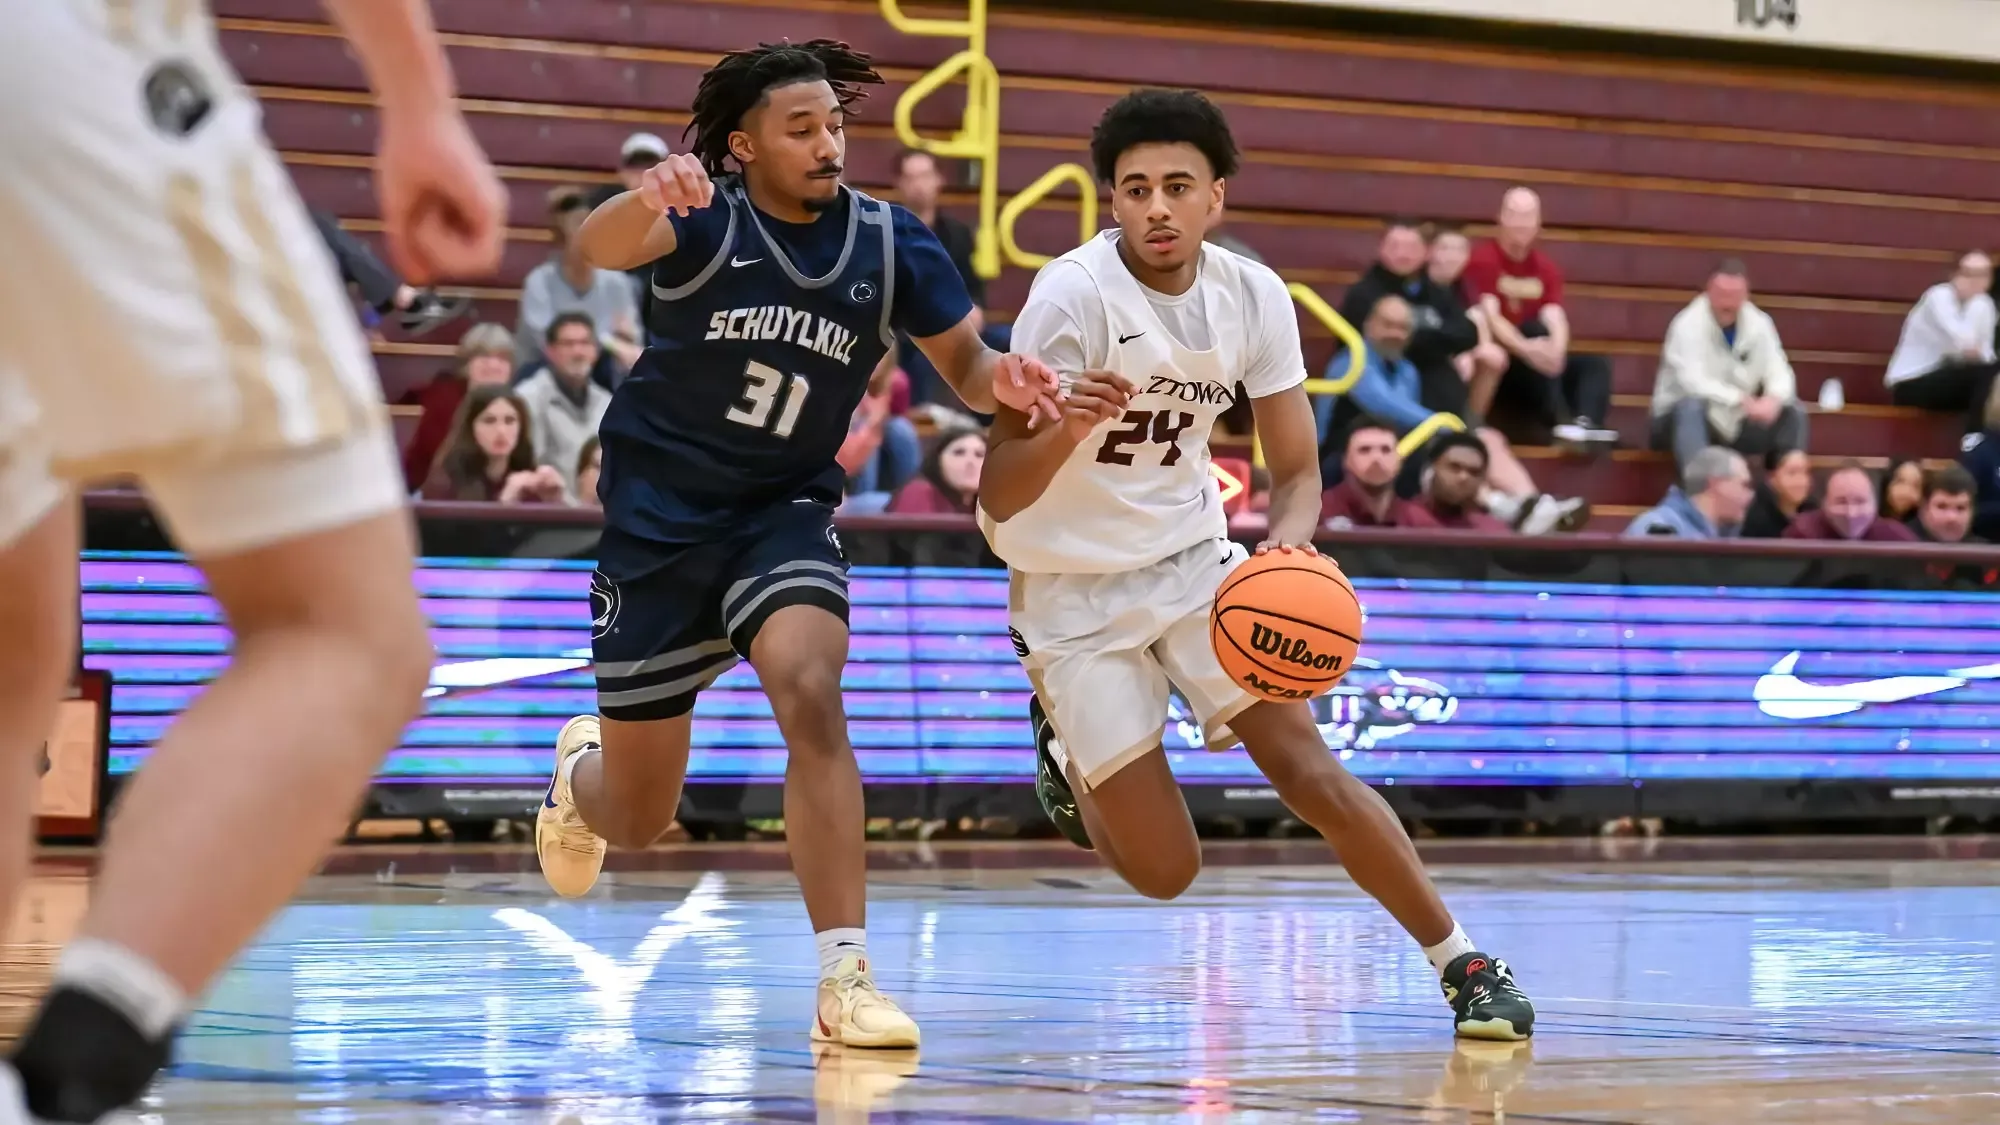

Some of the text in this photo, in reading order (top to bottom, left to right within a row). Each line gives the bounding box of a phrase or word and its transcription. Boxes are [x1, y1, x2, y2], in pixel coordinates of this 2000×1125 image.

[704, 305, 858, 366] SCHUYLKILL
[725, 358, 811, 440] 31
[1128, 375, 1236, 404] ZTOWN
[1095, 409, 1194, 466] 24
[1250, 621, 1343, 671] Wilson
[1243, 672, 1313, 698] NCAA
